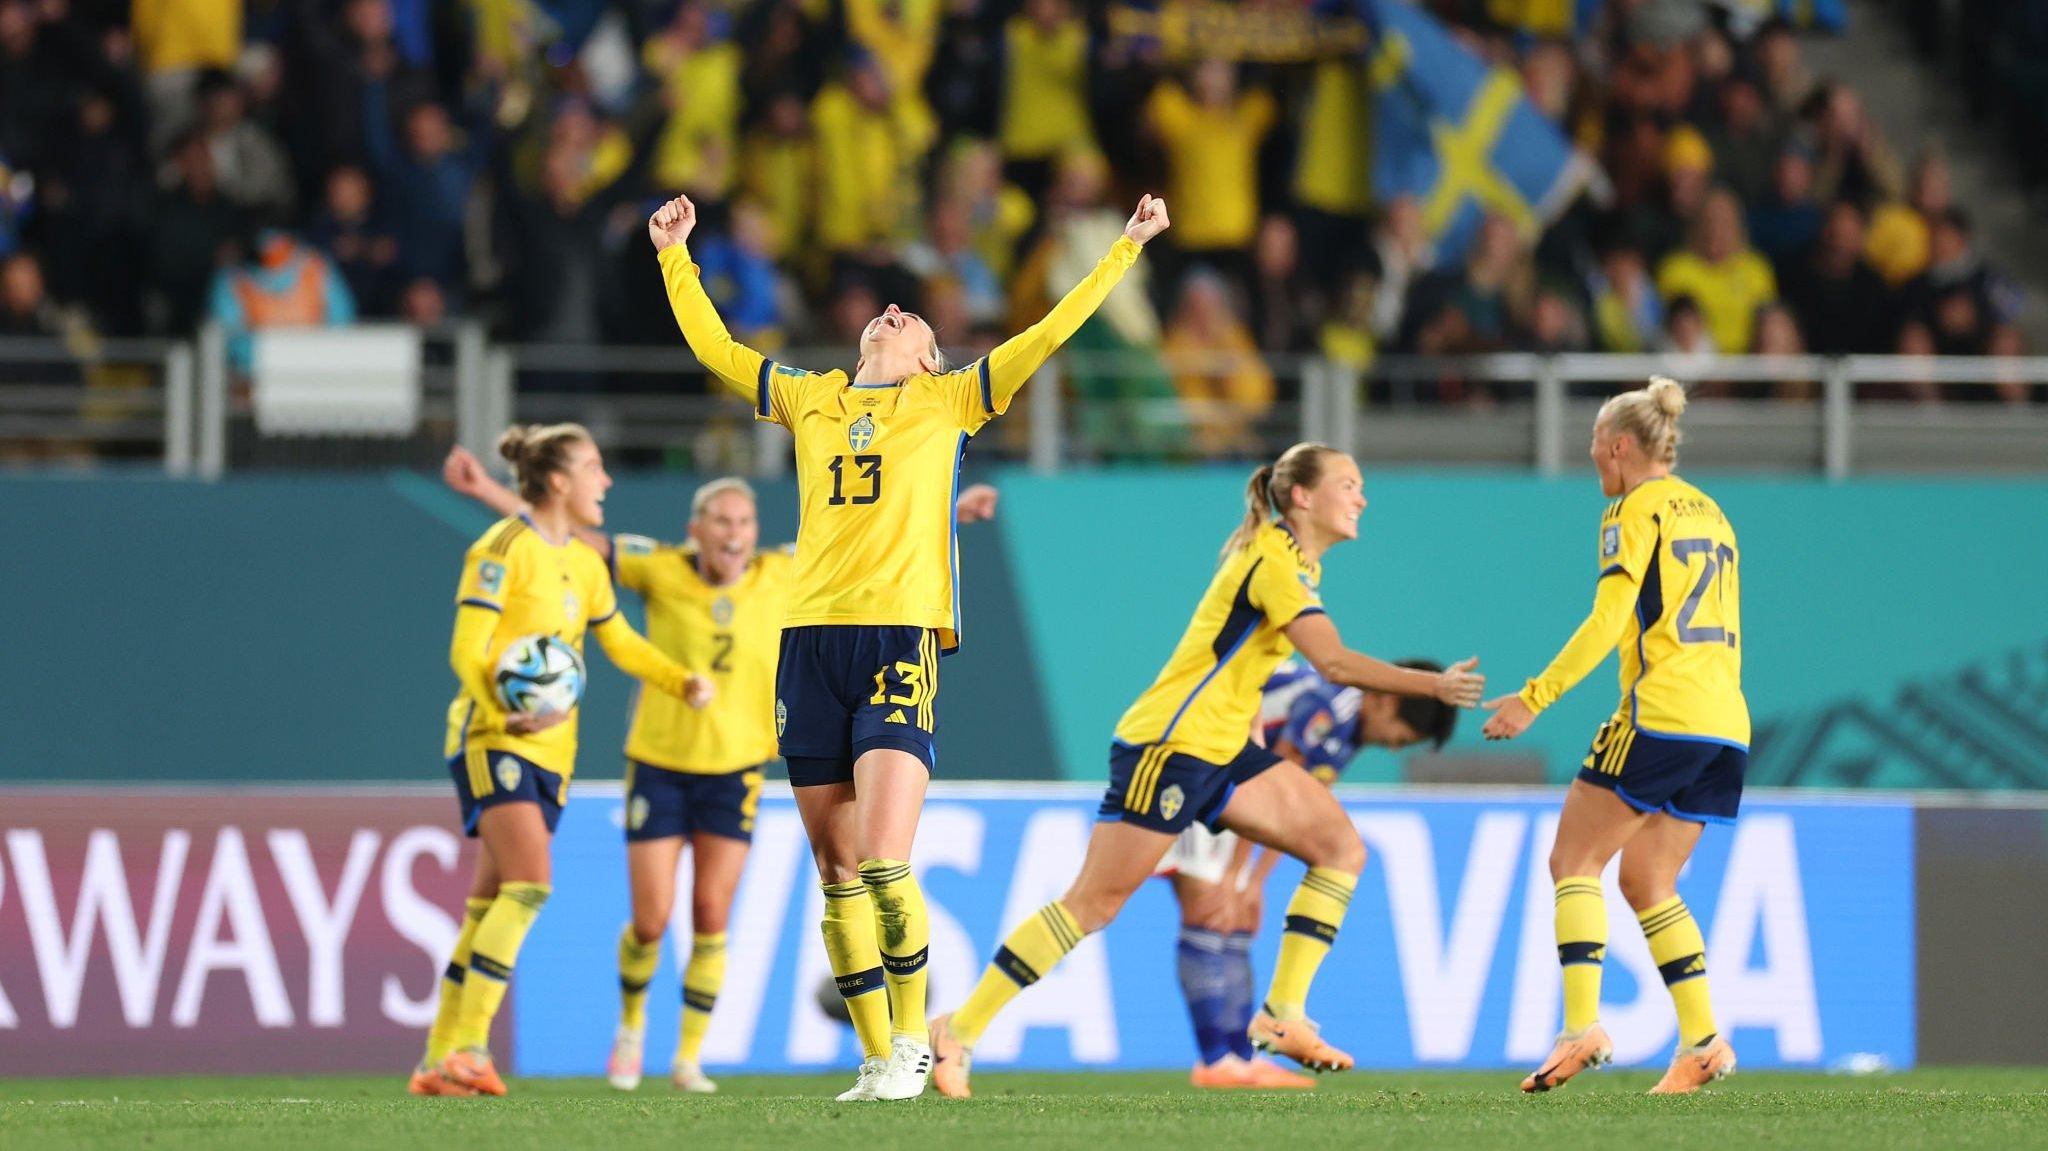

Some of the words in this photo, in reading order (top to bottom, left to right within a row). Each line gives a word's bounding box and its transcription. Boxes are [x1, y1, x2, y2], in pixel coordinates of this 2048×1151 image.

[828, 455, 882, 505] 13
[711, 633, 734, 672] 2
[870, 661, 922, 707] 13
[0, 825, 461, 1028] WAYS
[1346, 810, 1824, 1063] VISA
